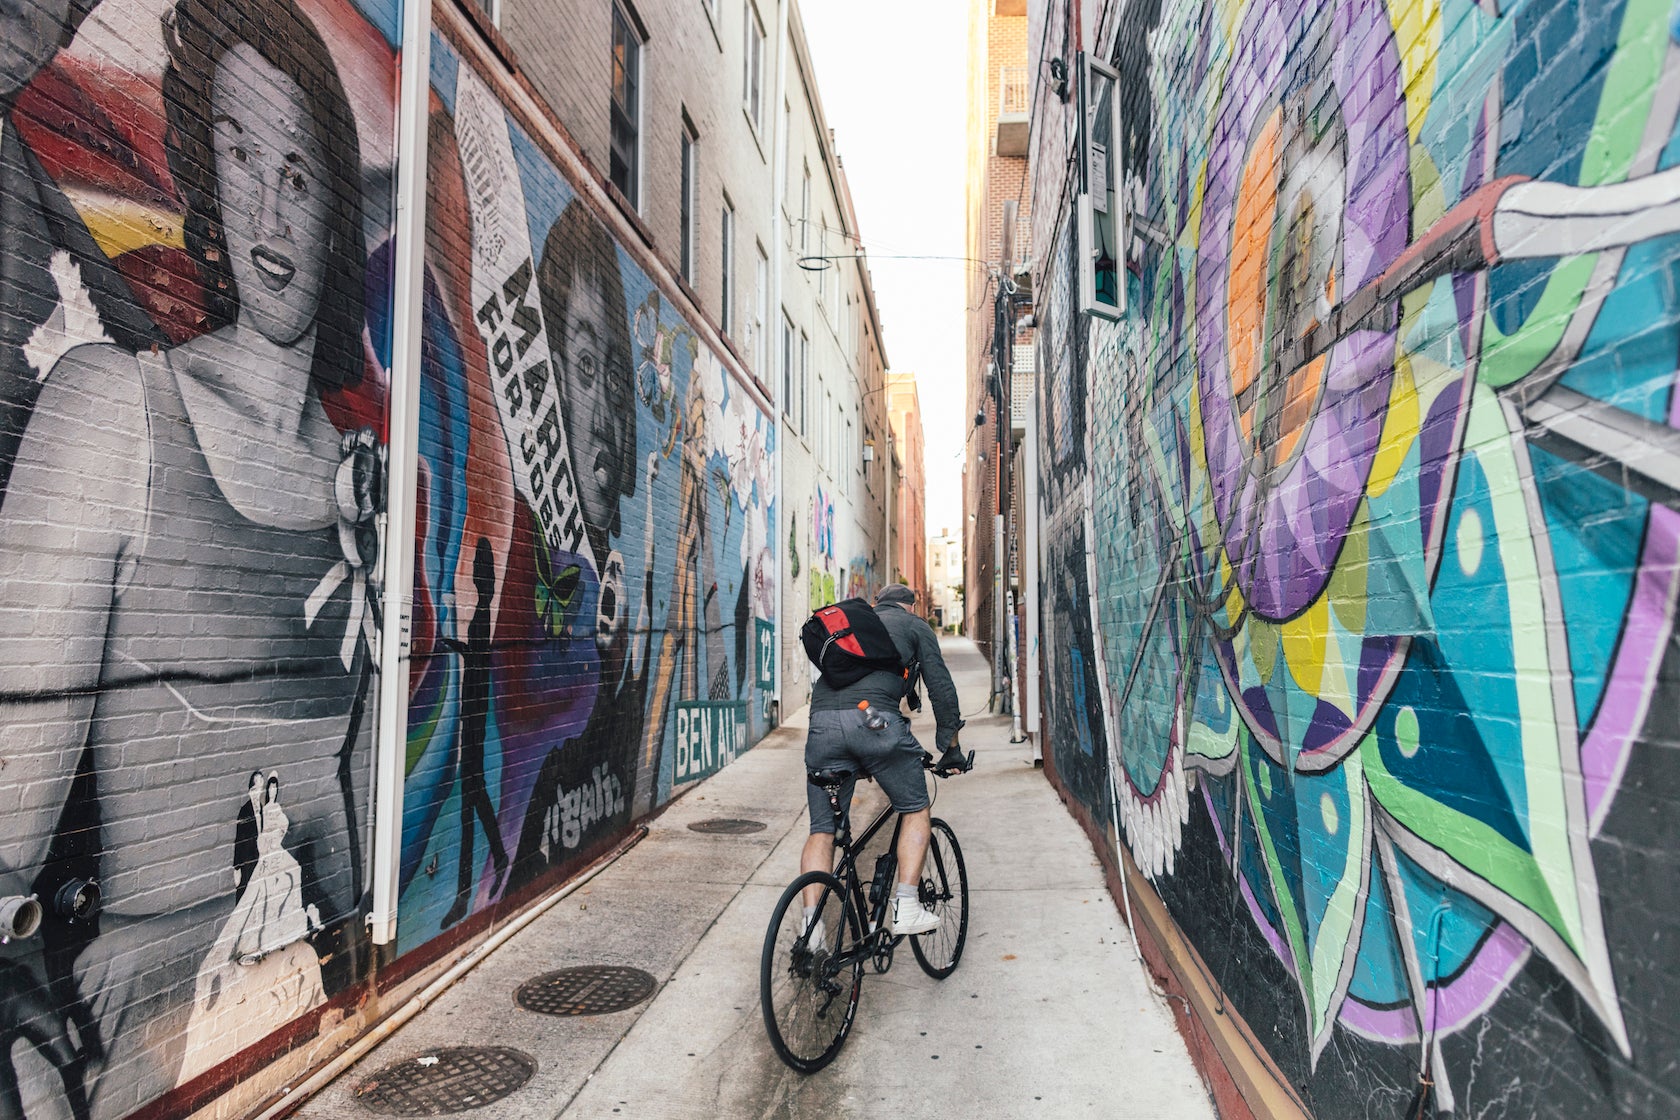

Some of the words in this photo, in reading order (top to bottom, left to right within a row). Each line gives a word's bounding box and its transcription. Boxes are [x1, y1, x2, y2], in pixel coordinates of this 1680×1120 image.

[477, 293, 523, 418] FOR
[520, 427, 562, 550] JOBS
[503, 255, 584, 554] MARCH
[676, 707, 712, 778] BEN
[717, 707, 736, 769] ALI
